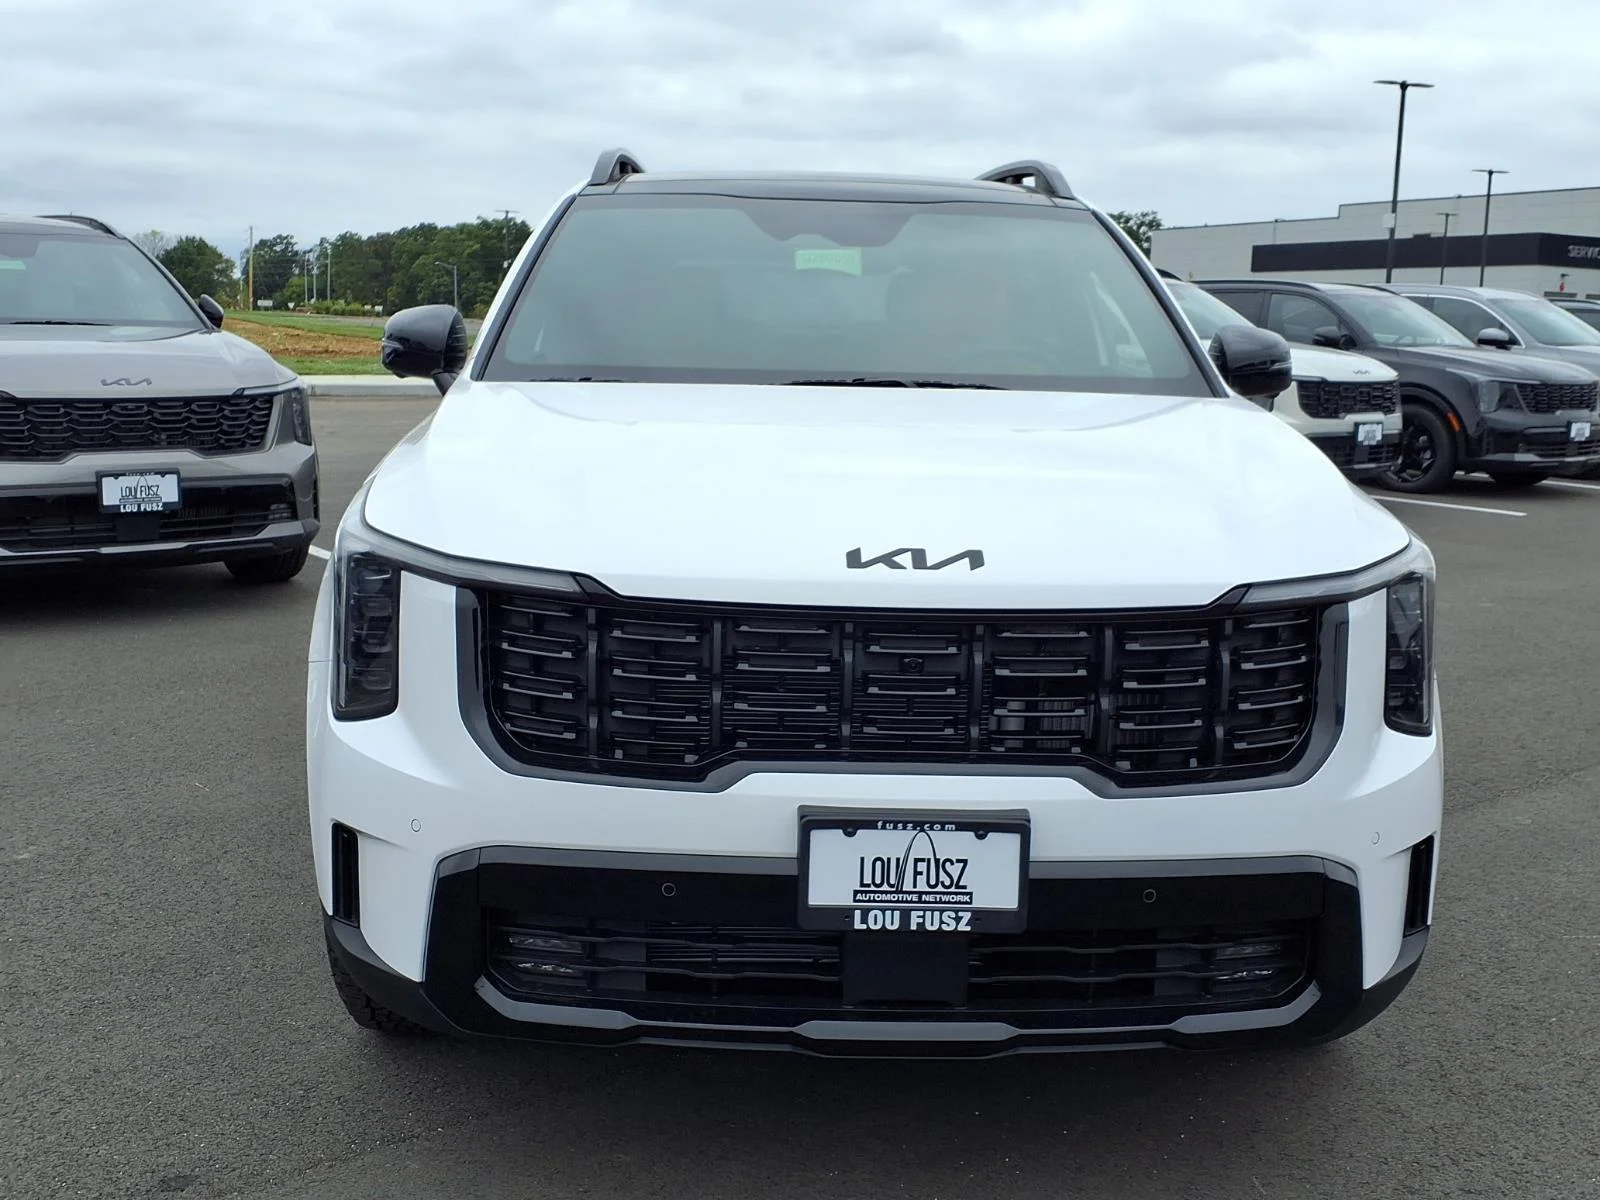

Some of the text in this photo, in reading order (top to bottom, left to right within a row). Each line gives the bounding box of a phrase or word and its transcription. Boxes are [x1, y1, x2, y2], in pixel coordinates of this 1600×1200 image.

[120, 502, 163, 512] LOU FUSZ
[876, 820, 957, 831] fusz.com
[859, 856, 969, 890] LOU FUSZ
[855, 892, 971, 903] AUTOMOTIVE NETWORK
[853, 909, 972, 932] LOU FUSZ
